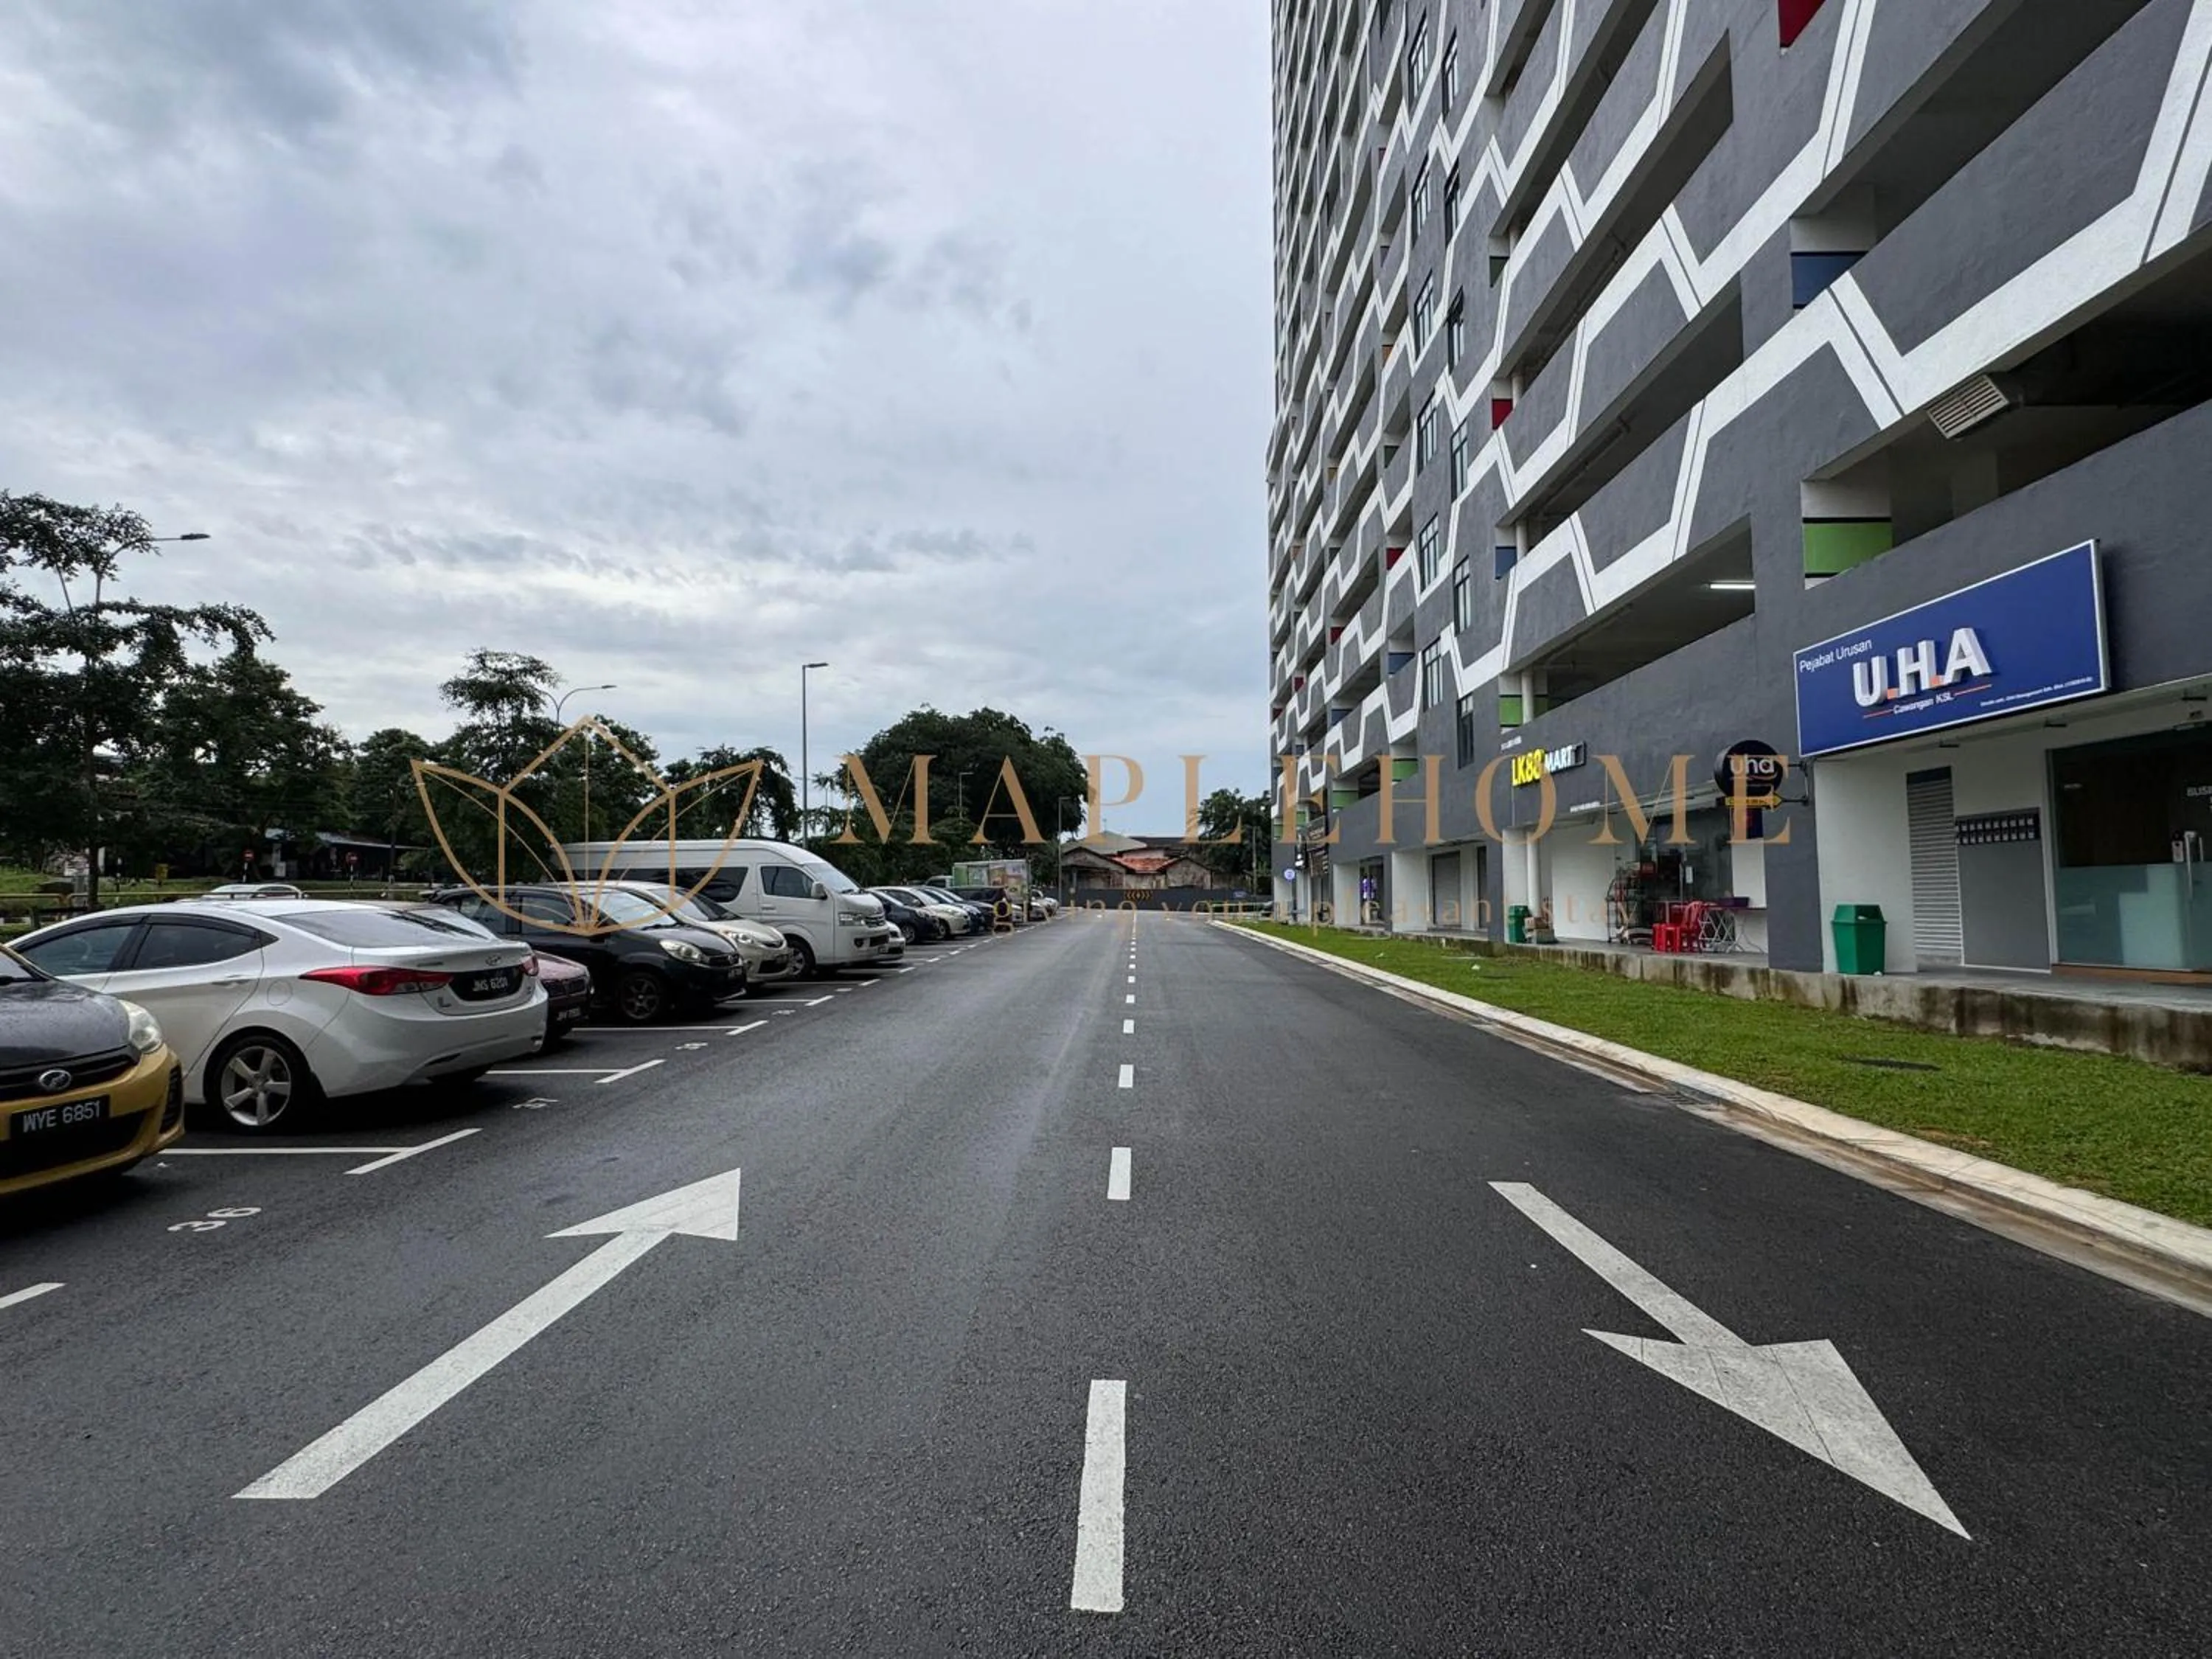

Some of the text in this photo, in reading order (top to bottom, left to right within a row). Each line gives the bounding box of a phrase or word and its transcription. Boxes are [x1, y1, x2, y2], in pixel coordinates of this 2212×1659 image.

[1799, 639, 1873, 674] Pejabat Urusan
[1893, 698, 1935, 714] Cawangan
[1545, 744, 1573, 773] MART
[23, 1100, 100, 1133] WYE 6851
